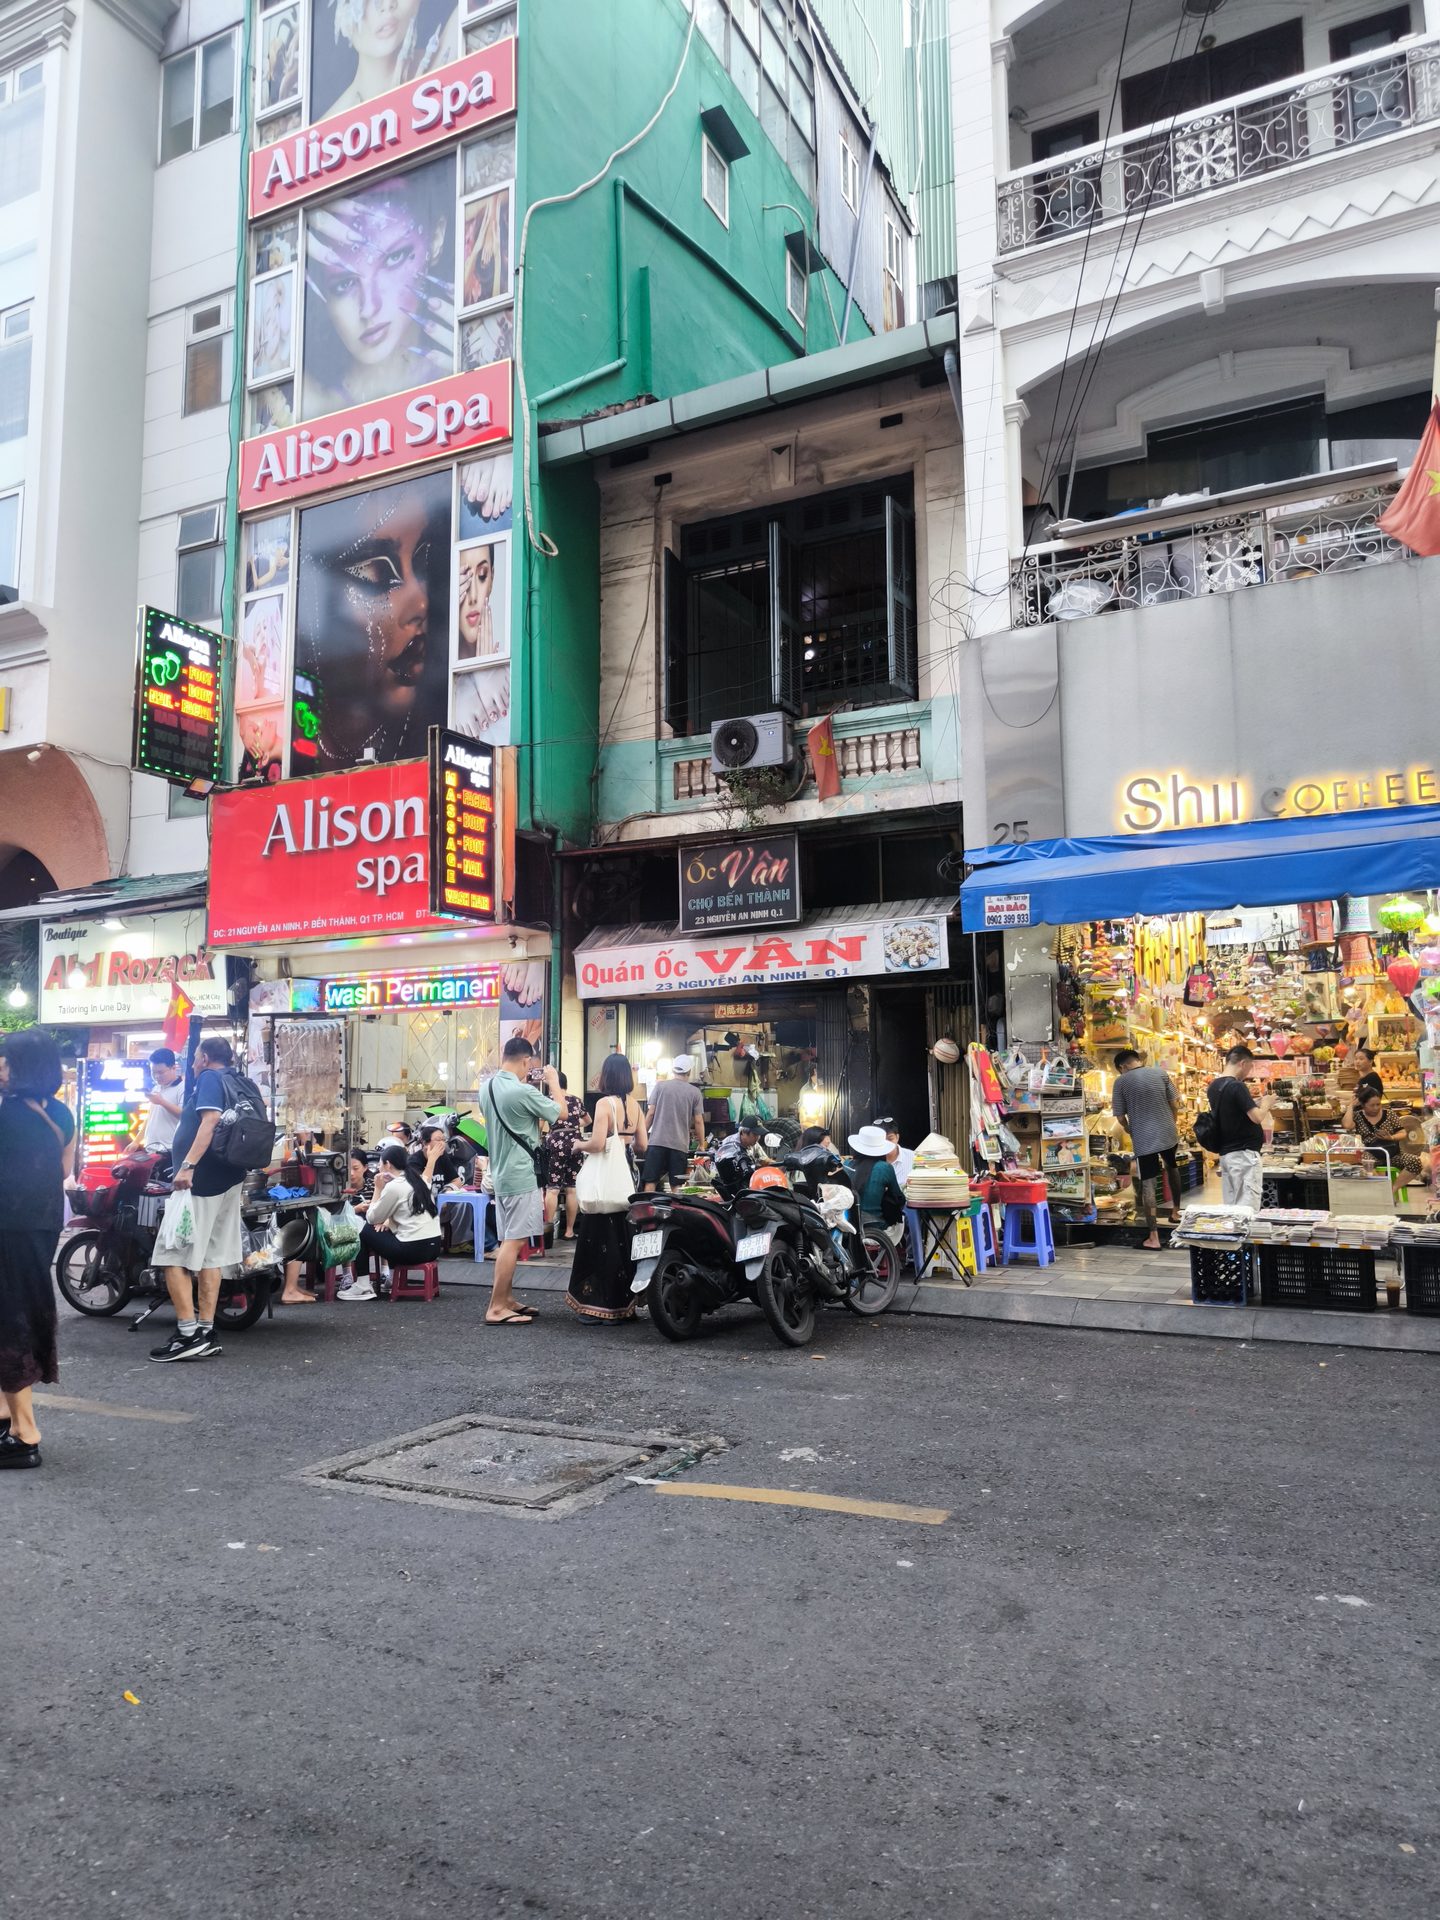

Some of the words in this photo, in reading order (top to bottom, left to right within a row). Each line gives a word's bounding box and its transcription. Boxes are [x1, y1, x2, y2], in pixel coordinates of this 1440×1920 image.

[262, 109, 400, 196] Alison
[411, 70, 496, 132] Spa
[252, 418, 393, 490] Alison
[405, 393, 491, 446] Spa
[159, 623, 211, 656] Alison
[444, 744, 492, 776] Alison
[1260, 769, 1437, 817] COFFEE
[262, 796, 428, 856] Alison
[445, 770, 457, 884] MASSAGE
[462, 811, 487, 833] BODY
[993, 820, 1030, 846] 25
[462, 834, 486, 856] FOOT
[356, 852, 428, 896] spa
[686, 851, 717, 884] Ốc
[720, 846, 790, 889] Vân
[687, 895, 714, 911] CHỢ
[717, 890, 744, 908] BẾN
[746, 887, 791, 905] THÀNH
[227, 928, 236, 936] 21
[270, 923, 281, 932] AN
[311, 916, 327, 928] BẾN
[359, 914, 370, 924] Q1
[385, 911, 404, 921] HCM
[694, 916, 705, 925] 23
[738, 911, 749, 921] AN
[750, 909, 769, 919] NINH
[770, 908, 784, 918] Q.1
[986, 914, 1003, 925] 0902
[1003, 914, 1016, 924] 399
[1016, 913, 1029, 923] 933
[44, 927, 88, 942] Boutique
[581, 961, 645, 988] Quán
[654, 949, 688, 979] Ốc
[695, 936, 867, 974] VÂN
[655, 983, 673, 992] 23
[742, 974, 765, 983] AN
[770, 970, 807, 982] NINH
[825, 967, 850, 978] Q.1
[326, 980, 380, 1006] wash
[58, 1005, 89, 1015] Tailoring
[116, 1002, 131, 1014] Day
